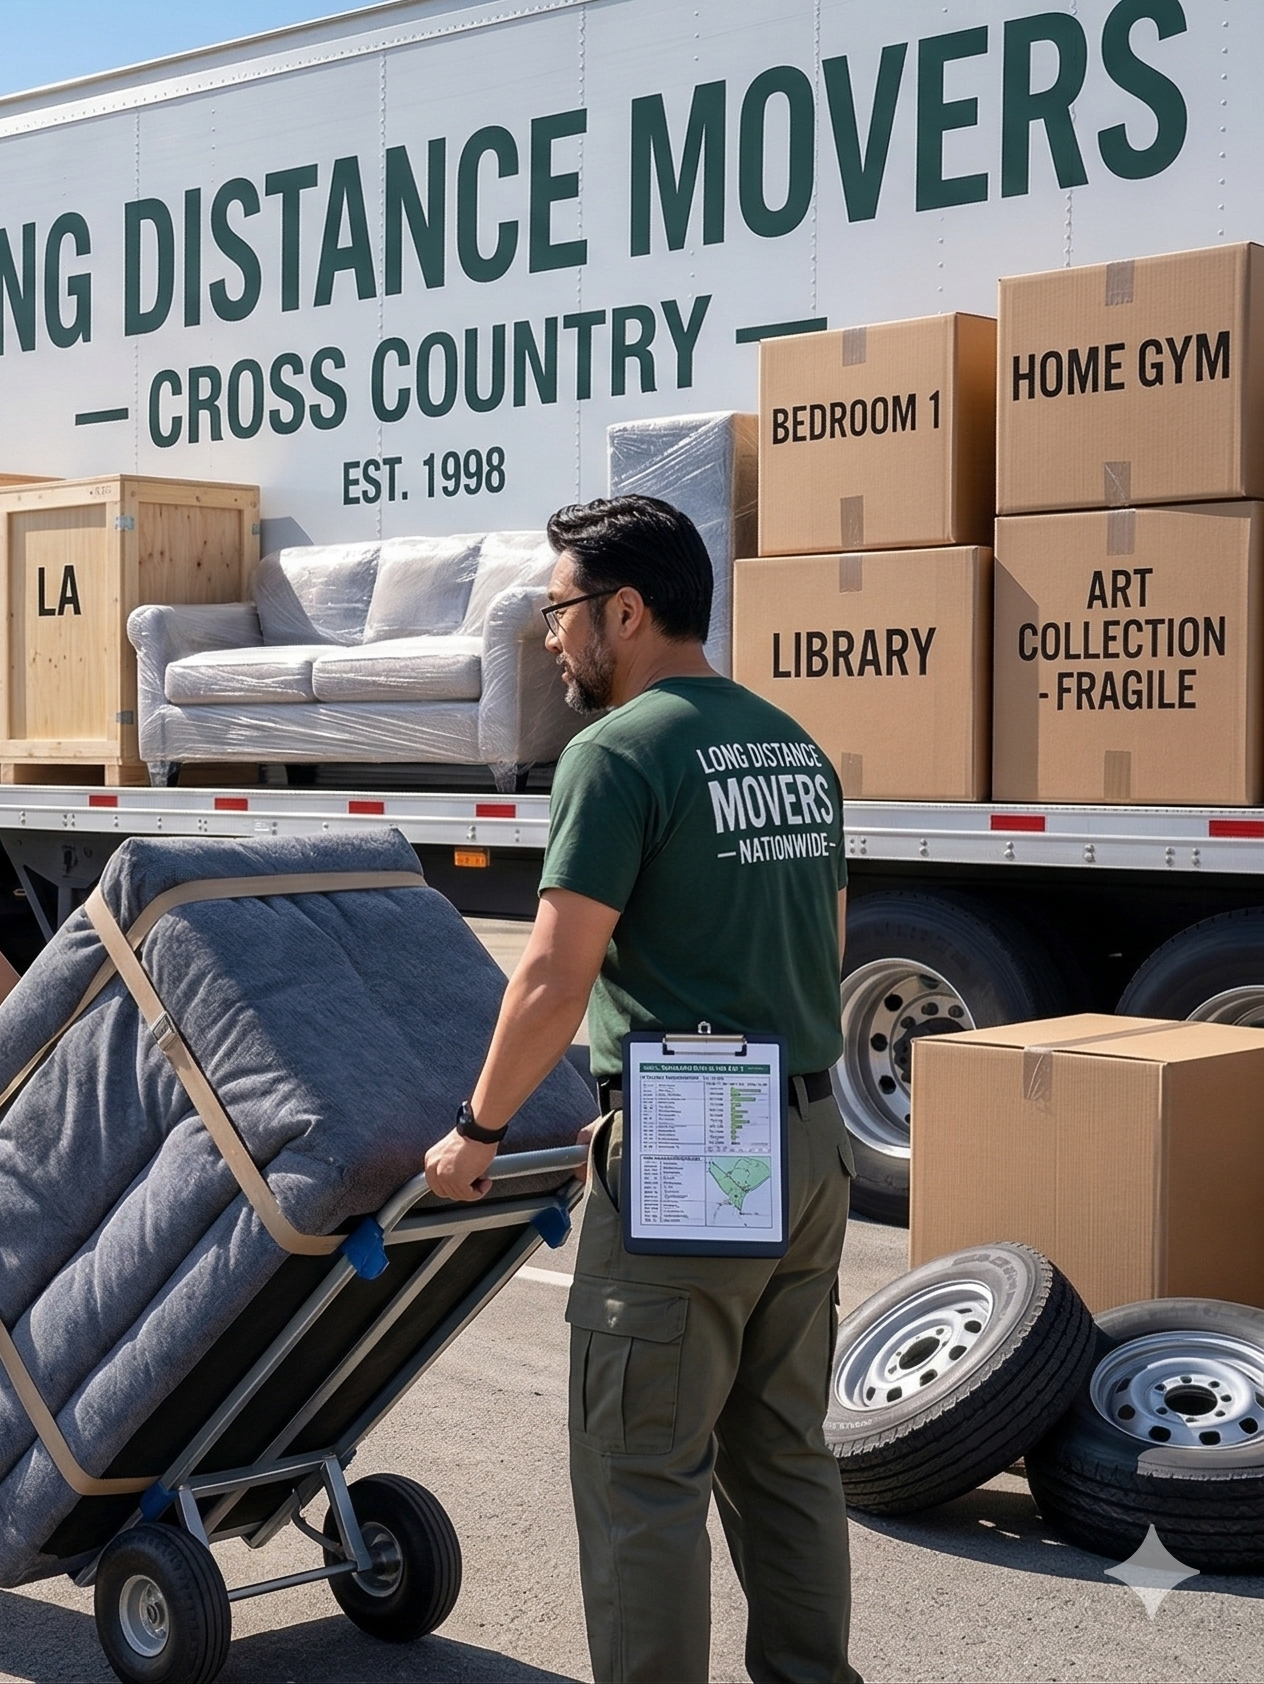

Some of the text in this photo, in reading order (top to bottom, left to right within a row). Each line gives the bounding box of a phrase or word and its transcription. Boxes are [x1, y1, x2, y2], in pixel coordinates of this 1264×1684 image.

[124, 107, 588, 337] DISTANCE
[630, 0, 1188, 258] MOVERS
[148, 294, 713, 449] CROSS COUNTRY
[1012, 330, 1231, 402] HOME GYM
[772, 389, 940, 445] BEDROOM 1
[343, 446, 506, 506] EST. 1998
[38, 564, 82, 617] LA
[1086, 567, 1154, 610] ART
[772, 626, 937, 679] LIBRARY
[1018, 615, 1226, 662] COLLECTION
[695, 742, 823, 774] LONG DISTANCE
[707, 773, 834, 834] MOVERS
